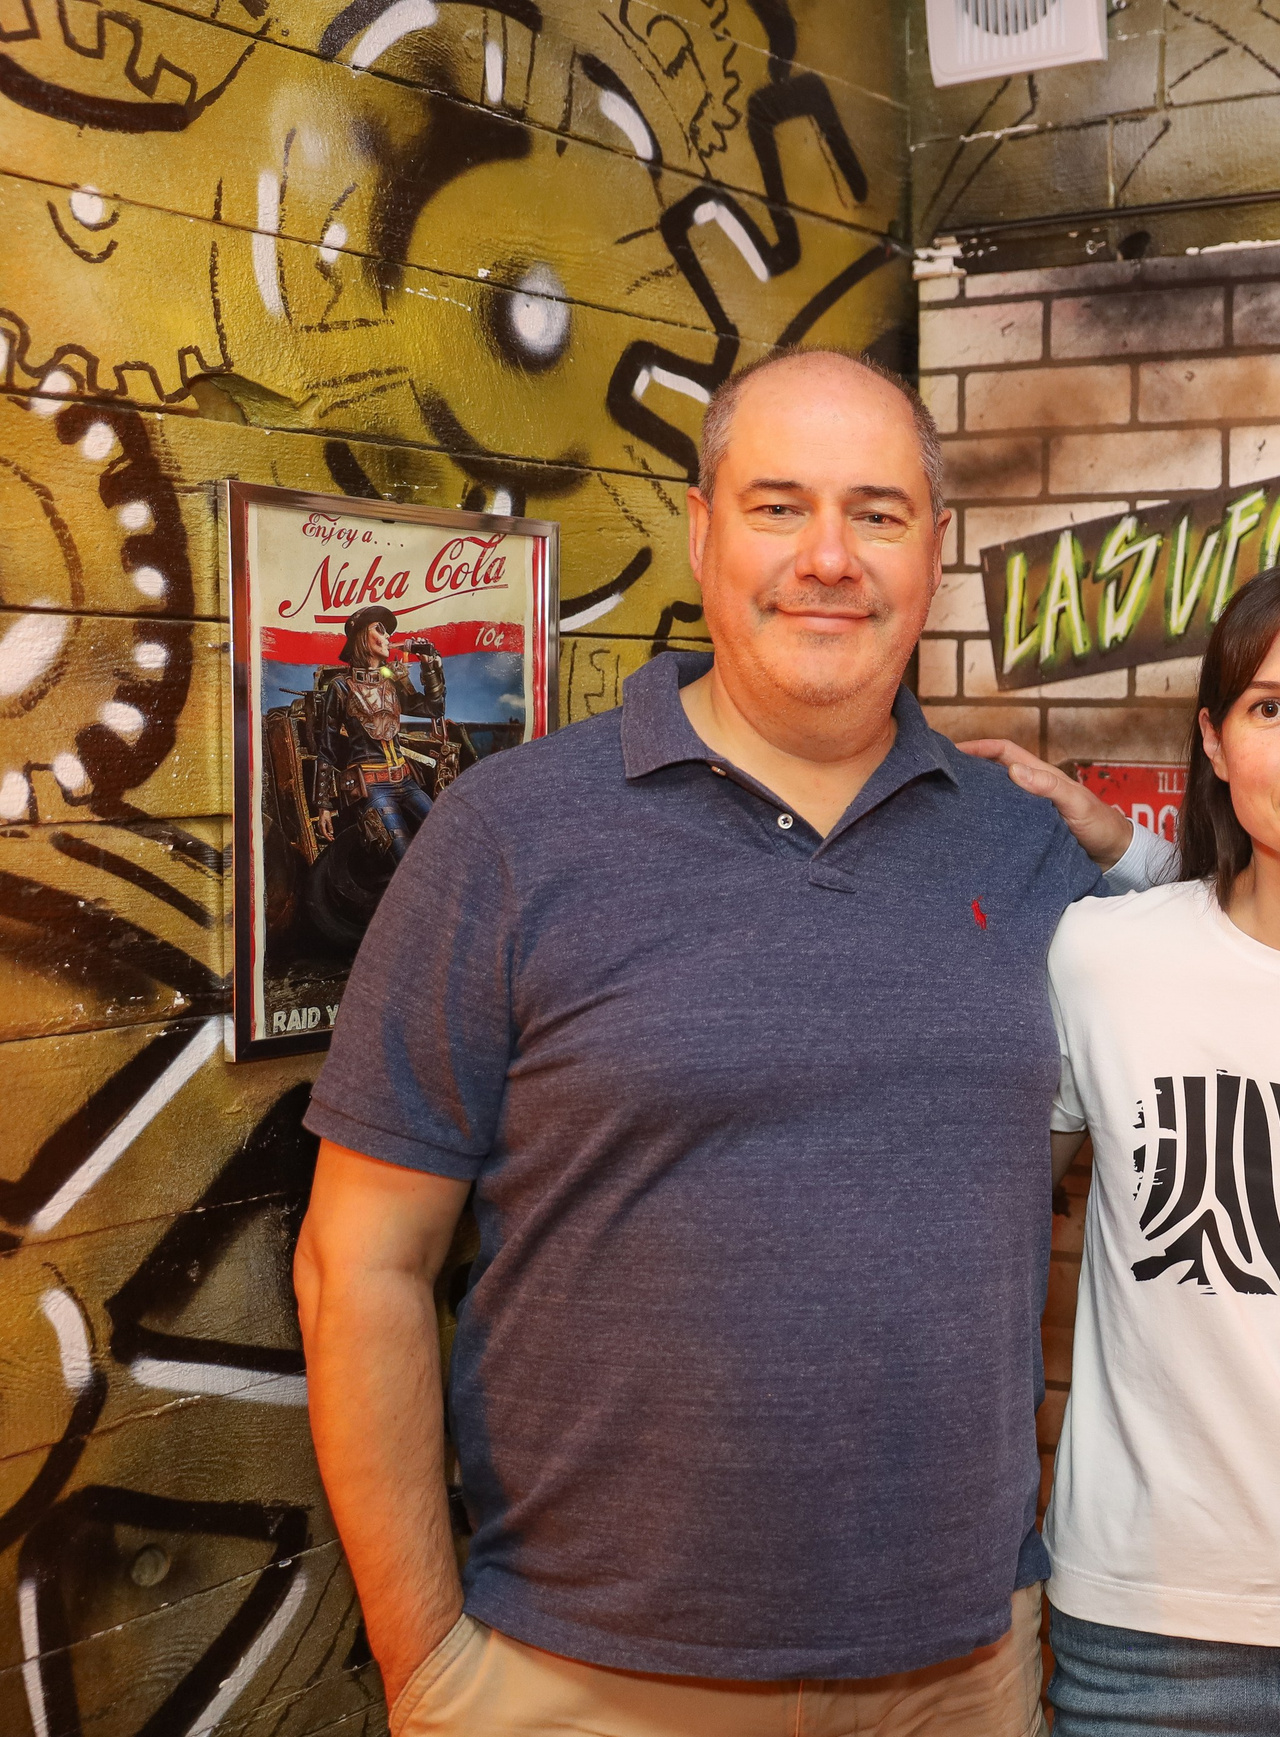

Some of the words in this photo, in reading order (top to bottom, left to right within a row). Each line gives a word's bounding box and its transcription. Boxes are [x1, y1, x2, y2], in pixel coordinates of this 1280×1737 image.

[302, 512, 358, 549] Enjoy
[278, 555, 411, 618] Nuka
[425, 533, 507, 593] Cola
[1003, 515, 1162, 675] LAS
[475, 626, 505, 649] 10¢
[273, 1006, 321, 1034] RAID
